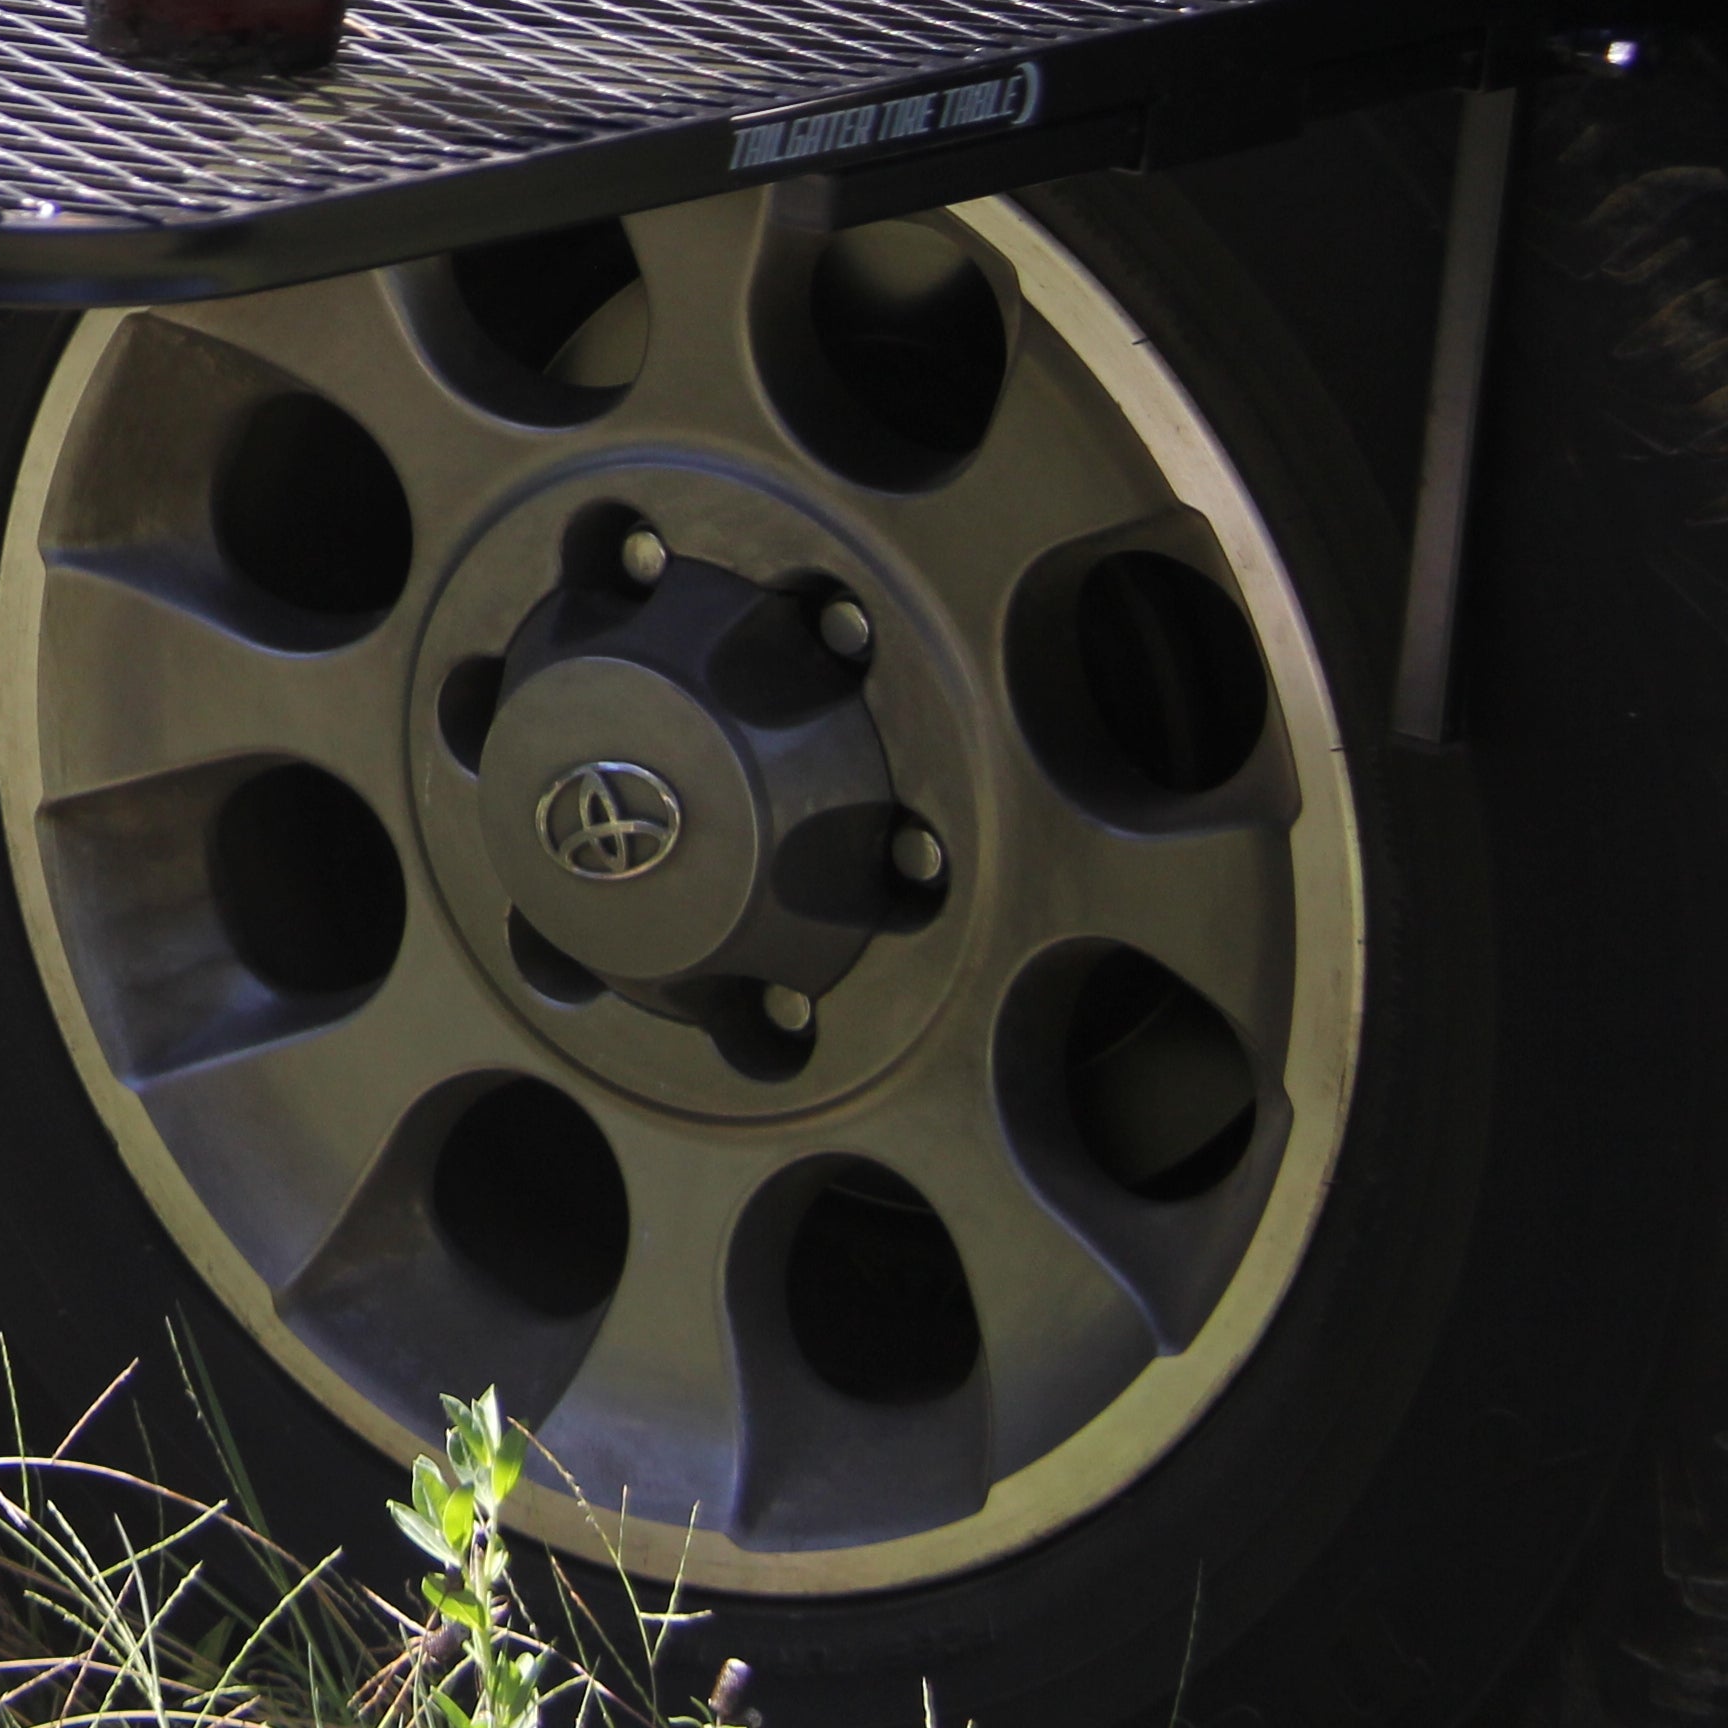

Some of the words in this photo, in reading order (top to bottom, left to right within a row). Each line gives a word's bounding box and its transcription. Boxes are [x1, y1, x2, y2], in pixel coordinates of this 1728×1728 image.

[730, 104, 877, 170] TAILGATER
[878, 92, 939, 141] TIRE
[940, 75, 1024, 128] TABLE
